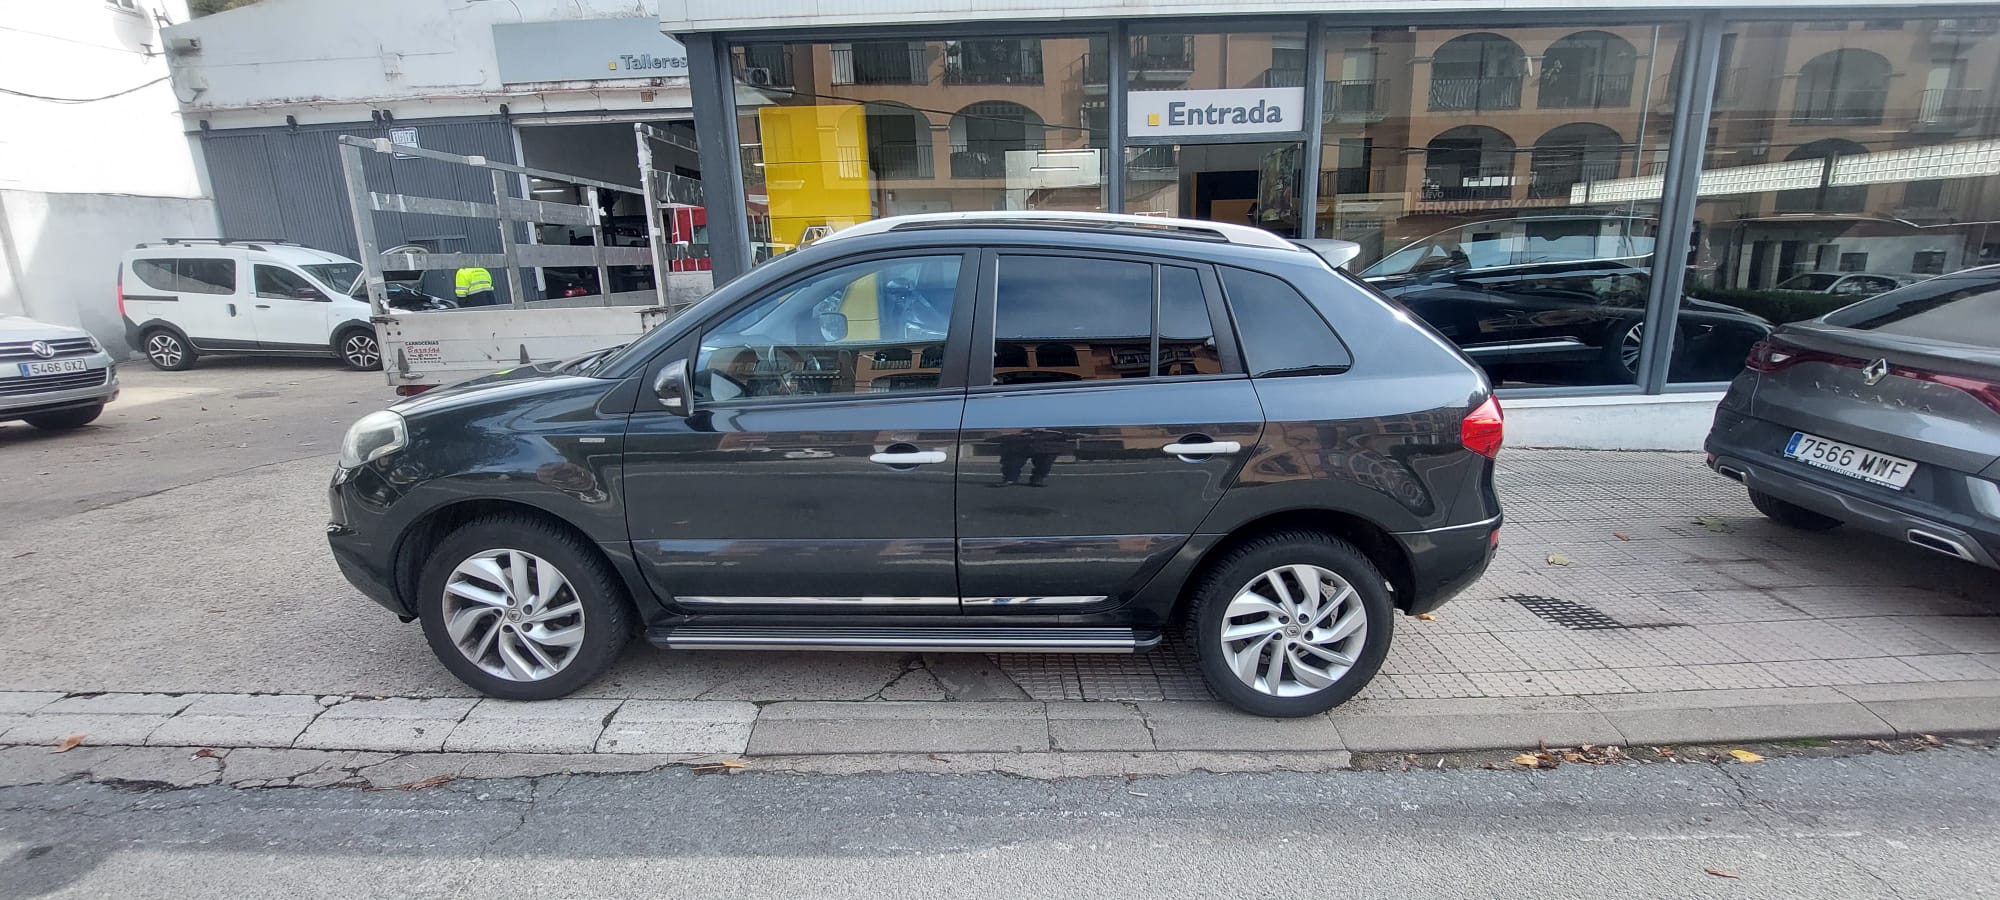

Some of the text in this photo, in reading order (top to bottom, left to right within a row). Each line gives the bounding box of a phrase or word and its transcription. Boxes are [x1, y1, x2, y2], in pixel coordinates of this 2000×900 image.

[620, 54, 688, 70] Talleres
[1168, 99, 1283, 126] Entrada
[1415, 198, 1556, 214] RENAULT ARKANA
[31, 360, 84, 374] 5466 GXZ
[1801, 438, 1908, 480] 7566 MWF
